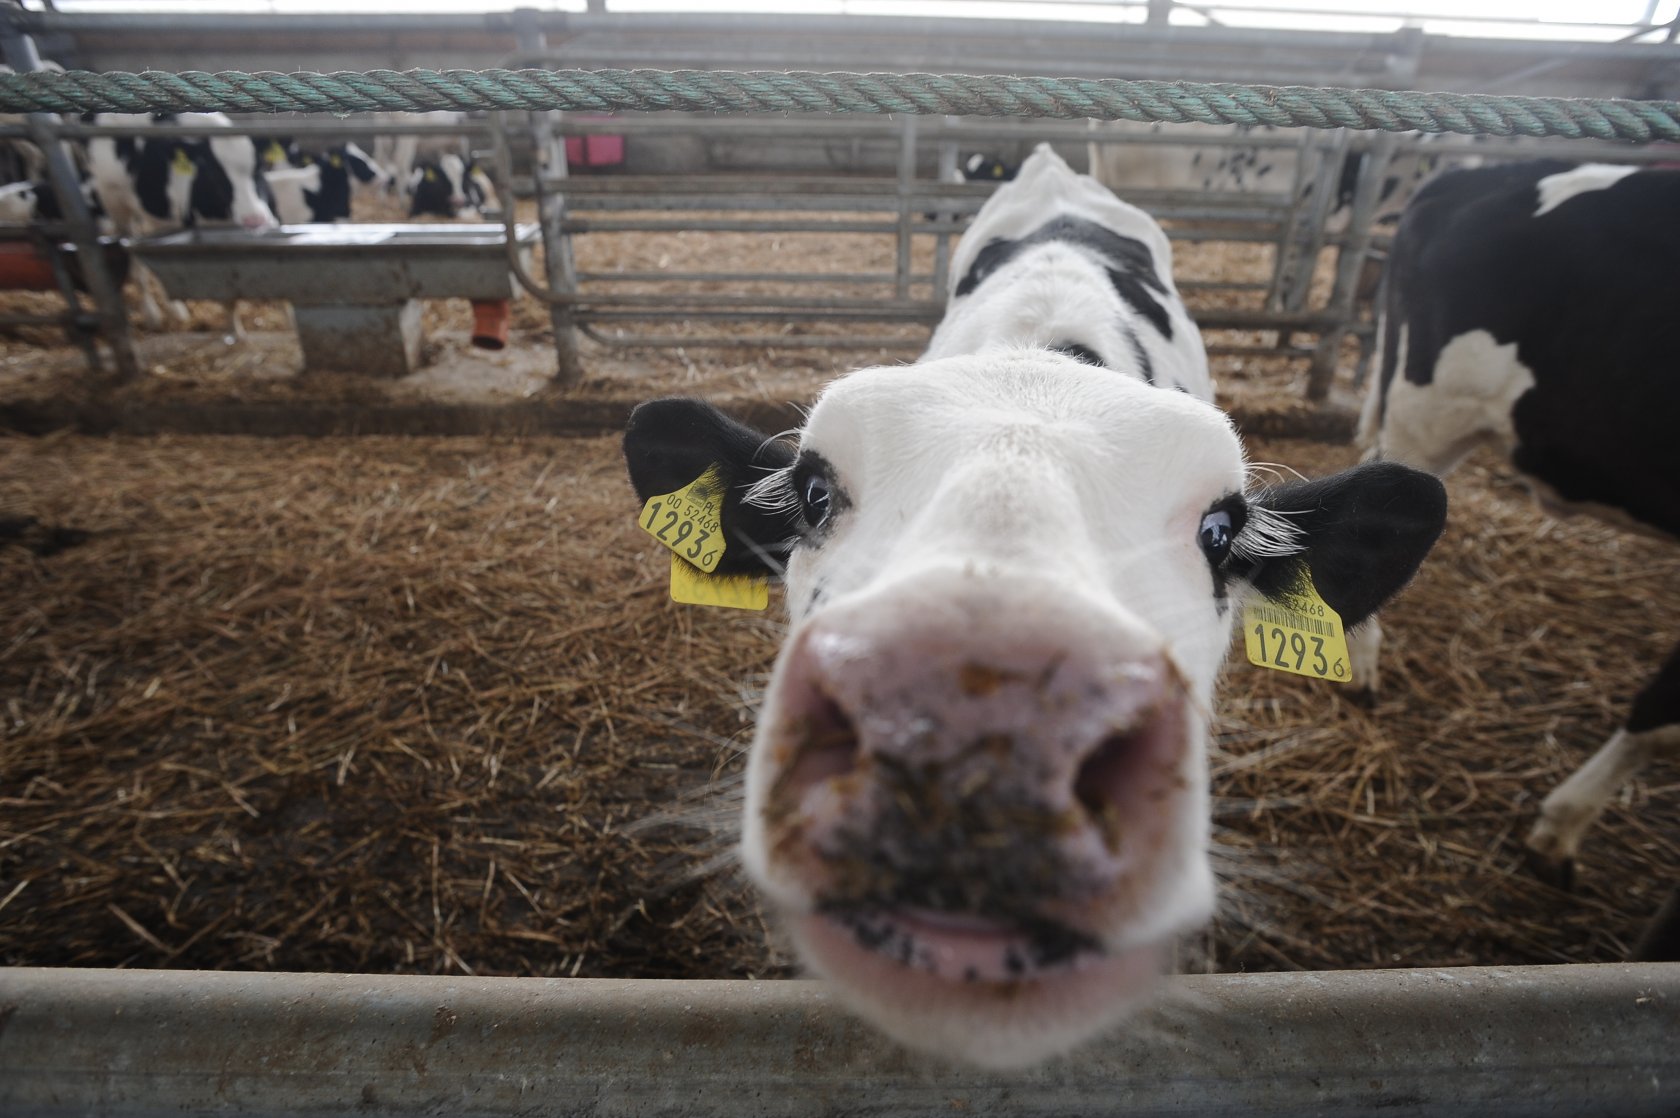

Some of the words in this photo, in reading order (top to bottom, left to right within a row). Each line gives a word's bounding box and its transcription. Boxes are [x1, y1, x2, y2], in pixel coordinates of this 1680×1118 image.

[667, 494, 682, 509] 00
[684, 505, 719, 533] 52468
[702, 501, 714, 516] PL
[646, 502, 711, 559] 1293
[702, 549, 718, 566] 6
[1254, 623, 1328, 676] 1293
[1333, 657, 1345, 677] 6
